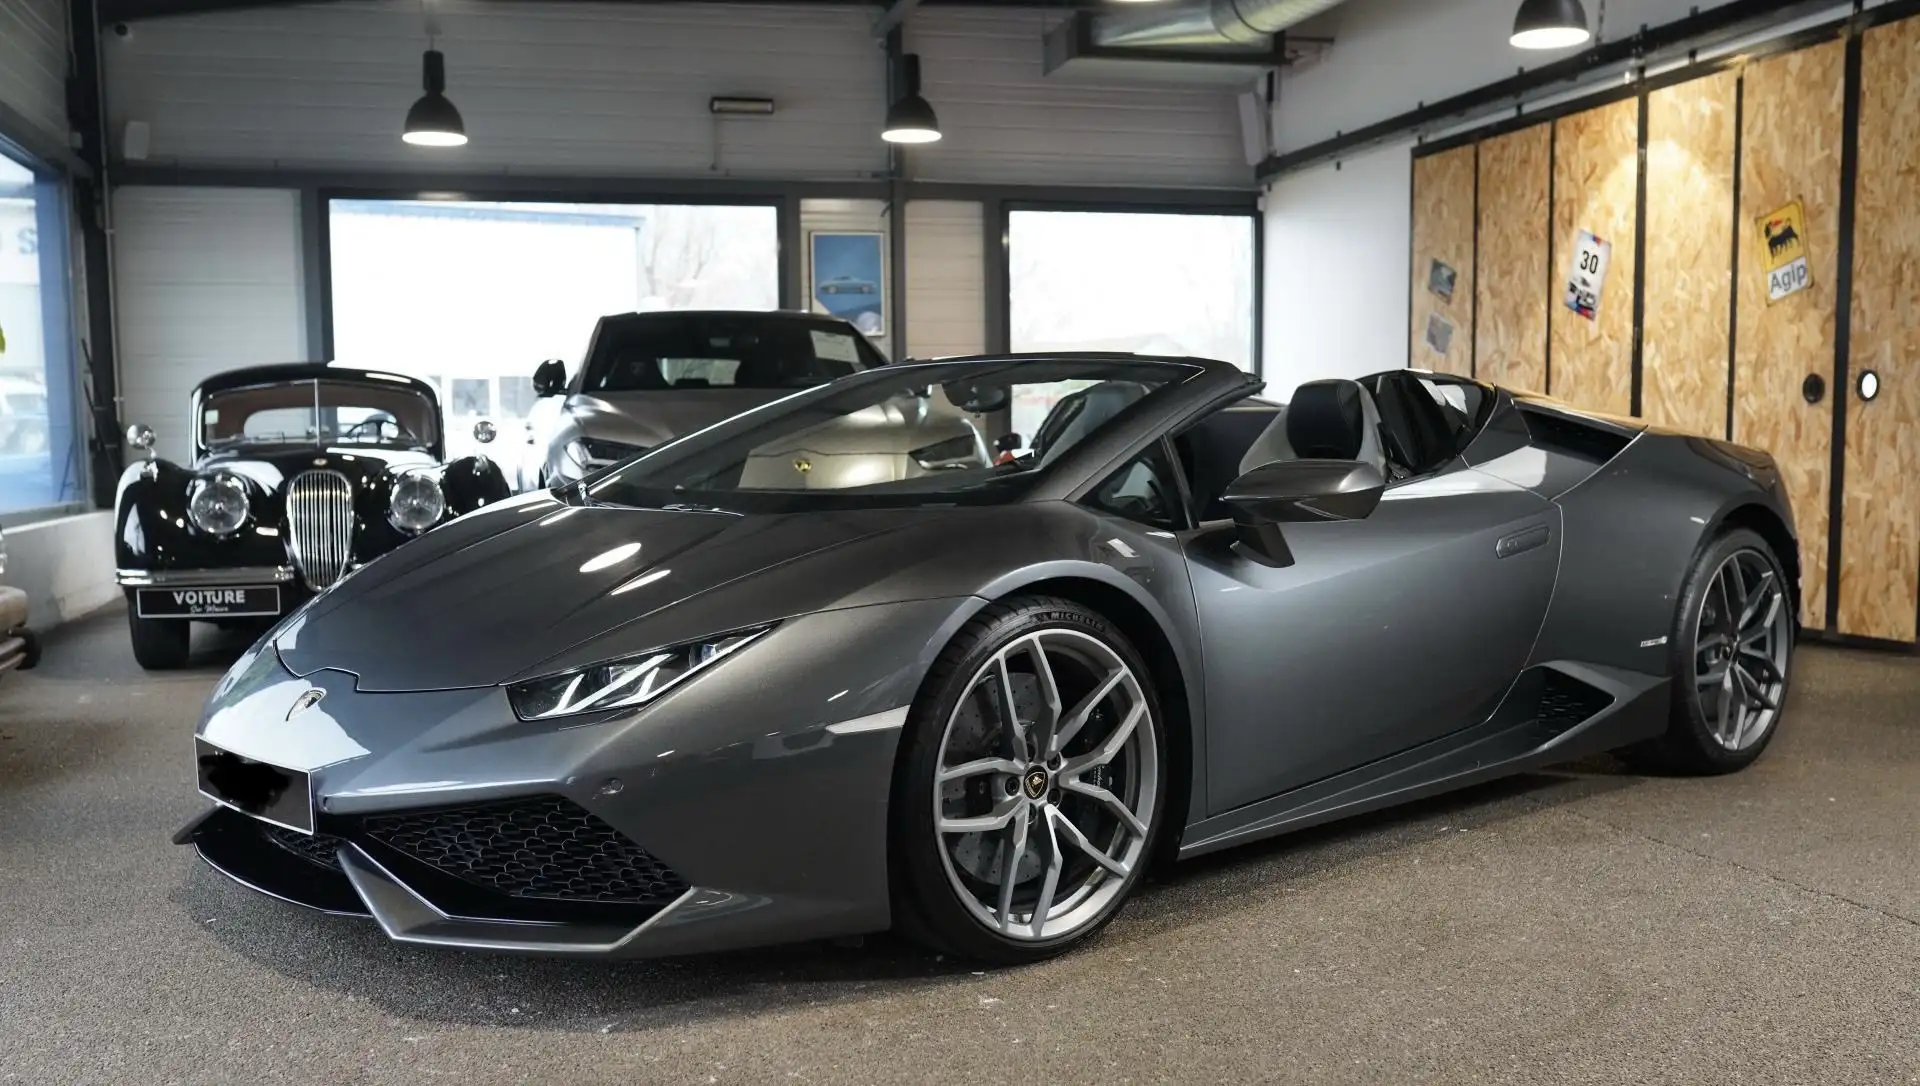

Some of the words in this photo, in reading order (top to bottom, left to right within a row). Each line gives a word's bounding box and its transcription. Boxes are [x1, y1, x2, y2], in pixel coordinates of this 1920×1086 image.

[1580, 250, 1599, 274] 30
[1769, 264, 1807, 293] Agip
[173, 590, 245, 605] VOITURE
